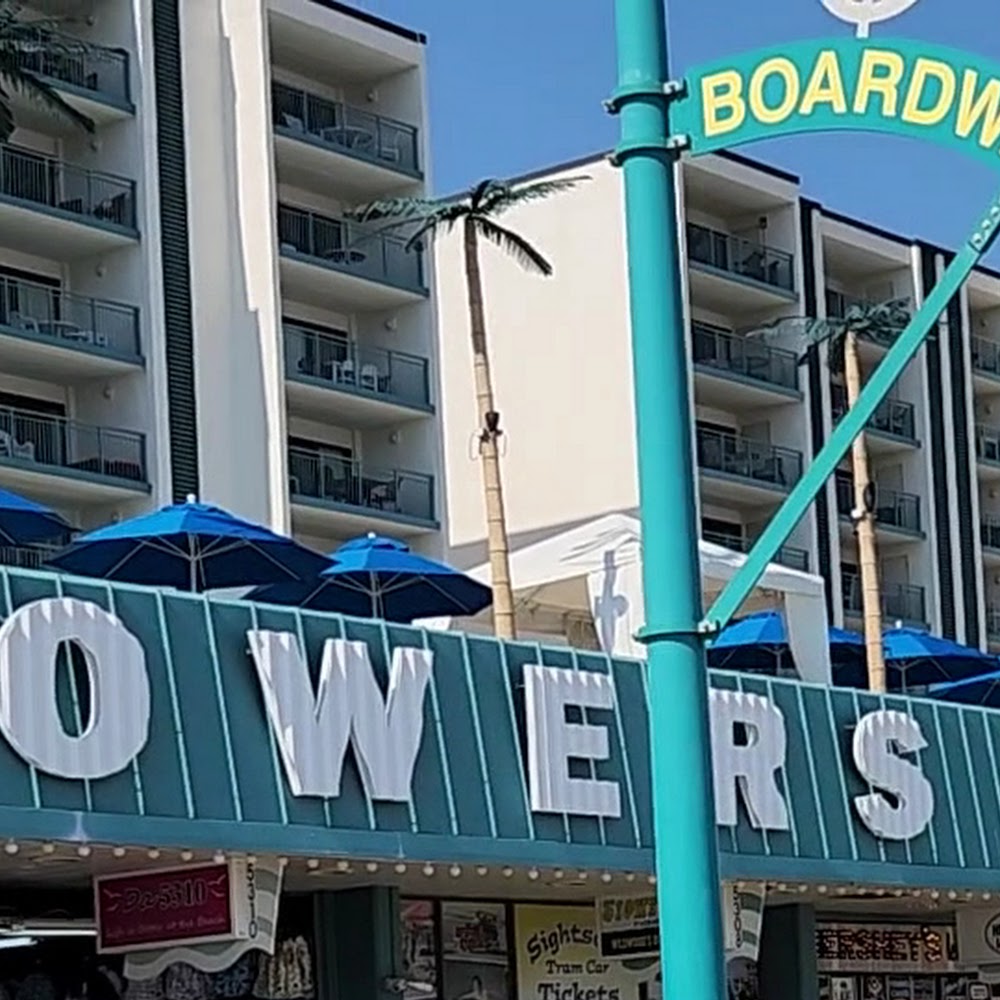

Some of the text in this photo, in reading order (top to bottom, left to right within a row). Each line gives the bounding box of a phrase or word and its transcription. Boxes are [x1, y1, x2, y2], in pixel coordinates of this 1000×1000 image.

[526, 922, 599, 965] Sights
[545, 960, 610, 975] Tram Car
